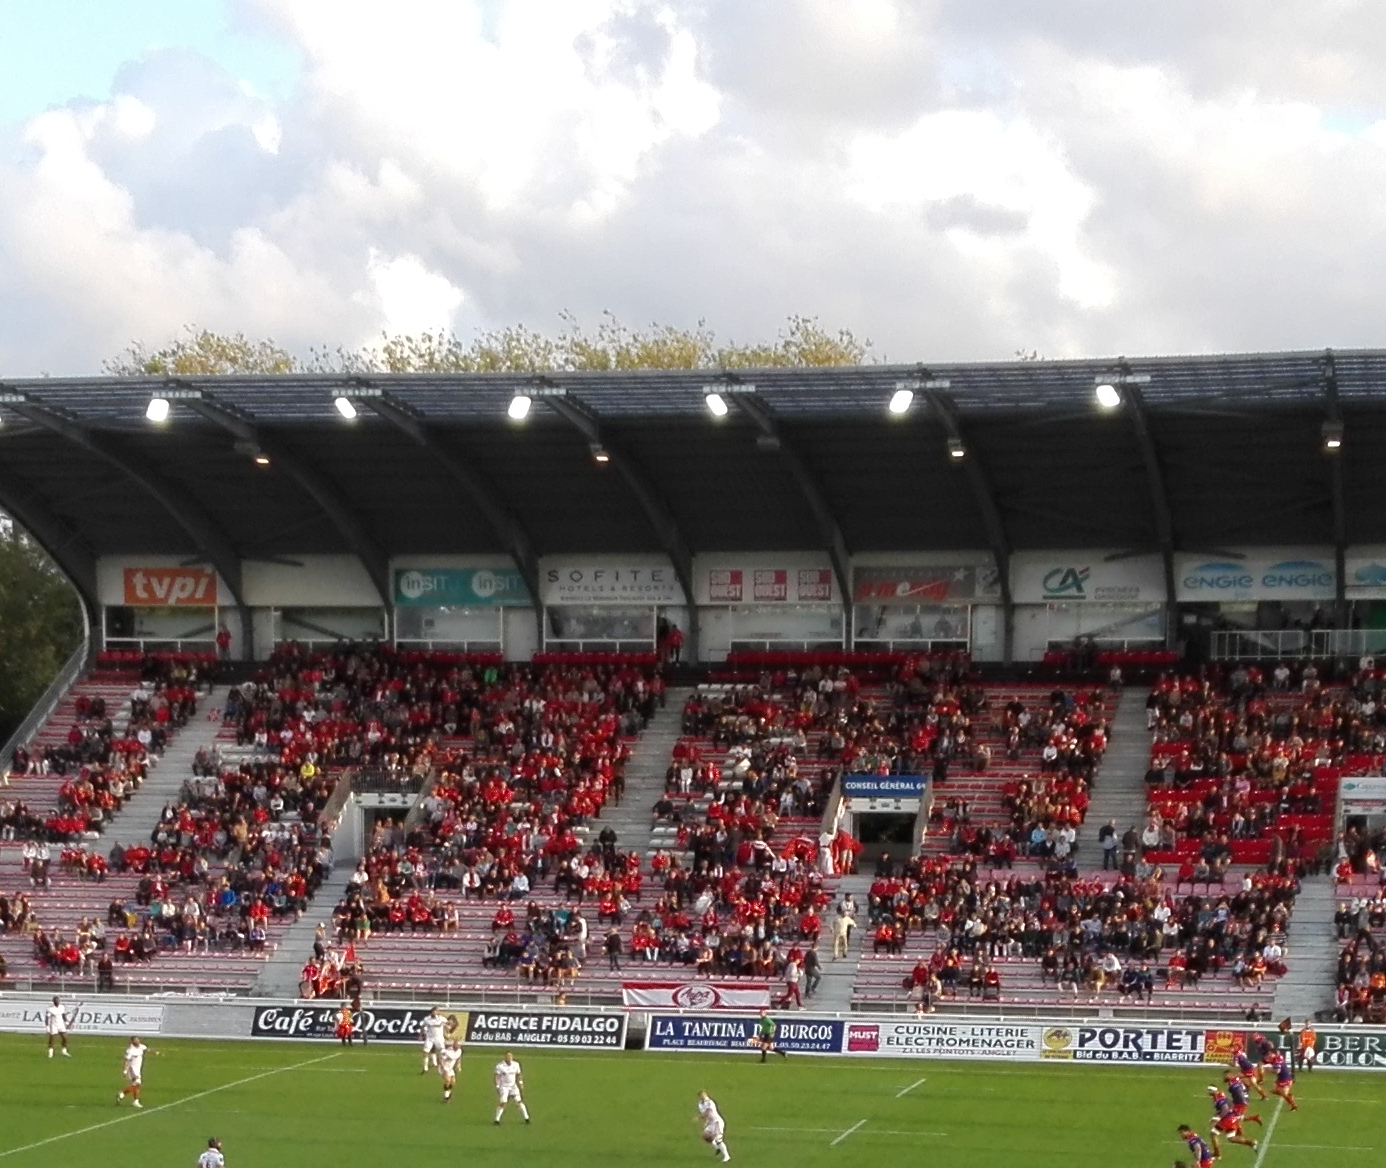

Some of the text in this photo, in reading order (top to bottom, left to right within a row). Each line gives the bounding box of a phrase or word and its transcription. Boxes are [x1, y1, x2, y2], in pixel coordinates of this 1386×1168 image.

[132, 567, 212, 605] tvpi
[845, 781, 878, 790] CONSEIL
[879, 781, 914, 790] GÉNÉRAL
[257, 1007, 427, 1035] Café Docks
[474, 1014, 619, 1033] AGENCE FIDALGO
[655, 1021, 833, 1040] LA TANTINA BURGOS
[849, 1031, 878, 1040] MUST
[894, 1026, 1029, 1038] CUISINE LITERIE
[471, 1031, 617, 1044] Bd du BAB ANGLET 05 59 03 22 44
[663, 1038, 685, 1046] PLACE
[687, 1039, 729, 1047] BEAURIVAGE
[885, 1036, 1036, 1050] ELECTROMENAGER
[1078, 1028, 1204, 1051] PORTET
[1095, 1051, 1109, 1060] du
[1154, 1052, 1203, 1062] BIARRITZ
